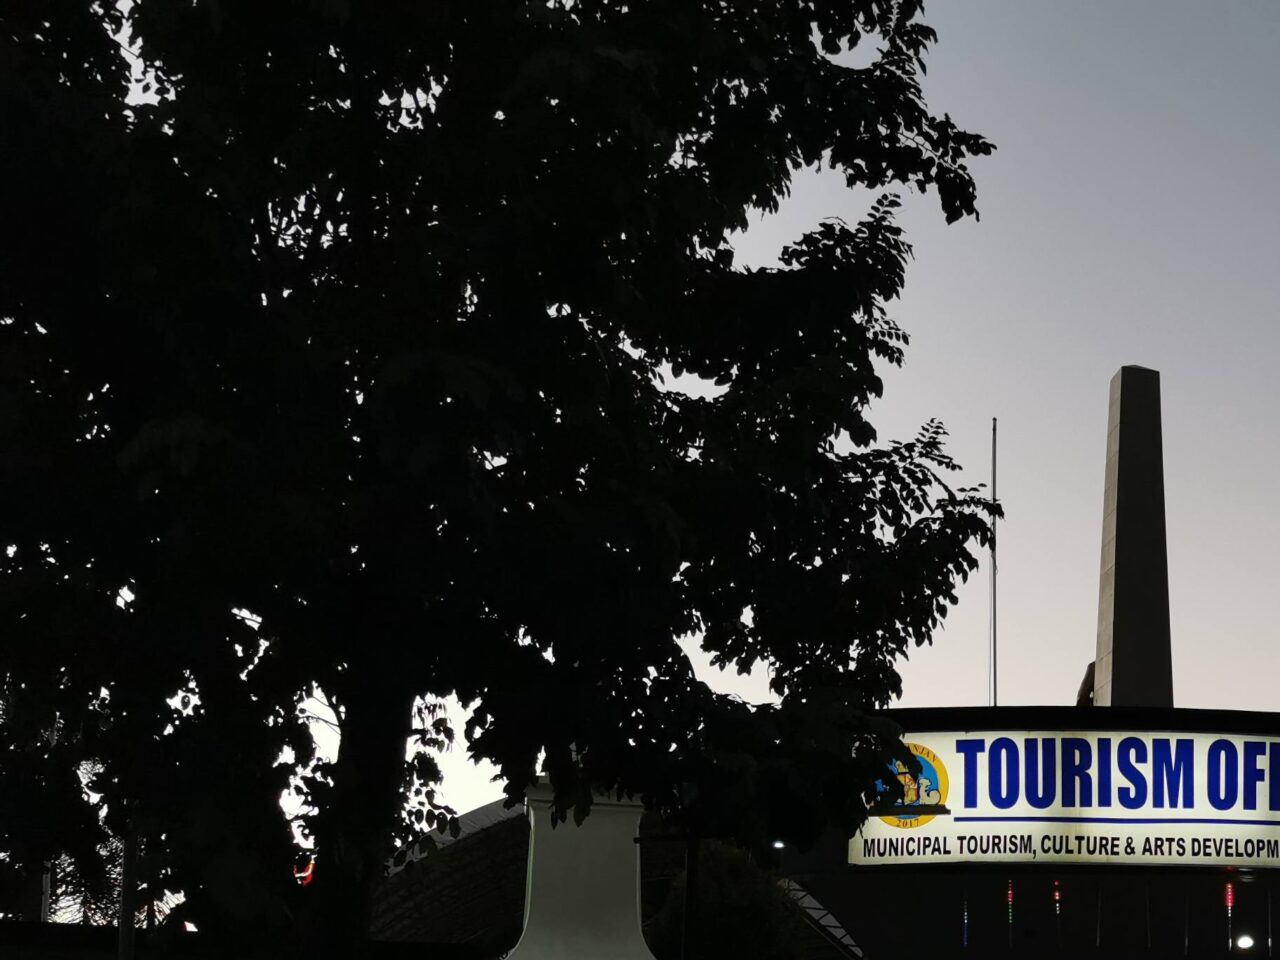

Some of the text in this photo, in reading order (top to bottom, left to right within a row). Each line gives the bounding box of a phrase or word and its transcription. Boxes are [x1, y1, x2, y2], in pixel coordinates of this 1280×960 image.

[955, 736, 1195, 810] TOURISM
[863, 836, 951, 858] MUNICIPAL
[957, 835, 1036, 859] TOURISM,
[1040, 834, 1120, 856] CULTURE
[1124, 836, 1136, 856] &
[1141, 836, 1186, 857] ARTS
